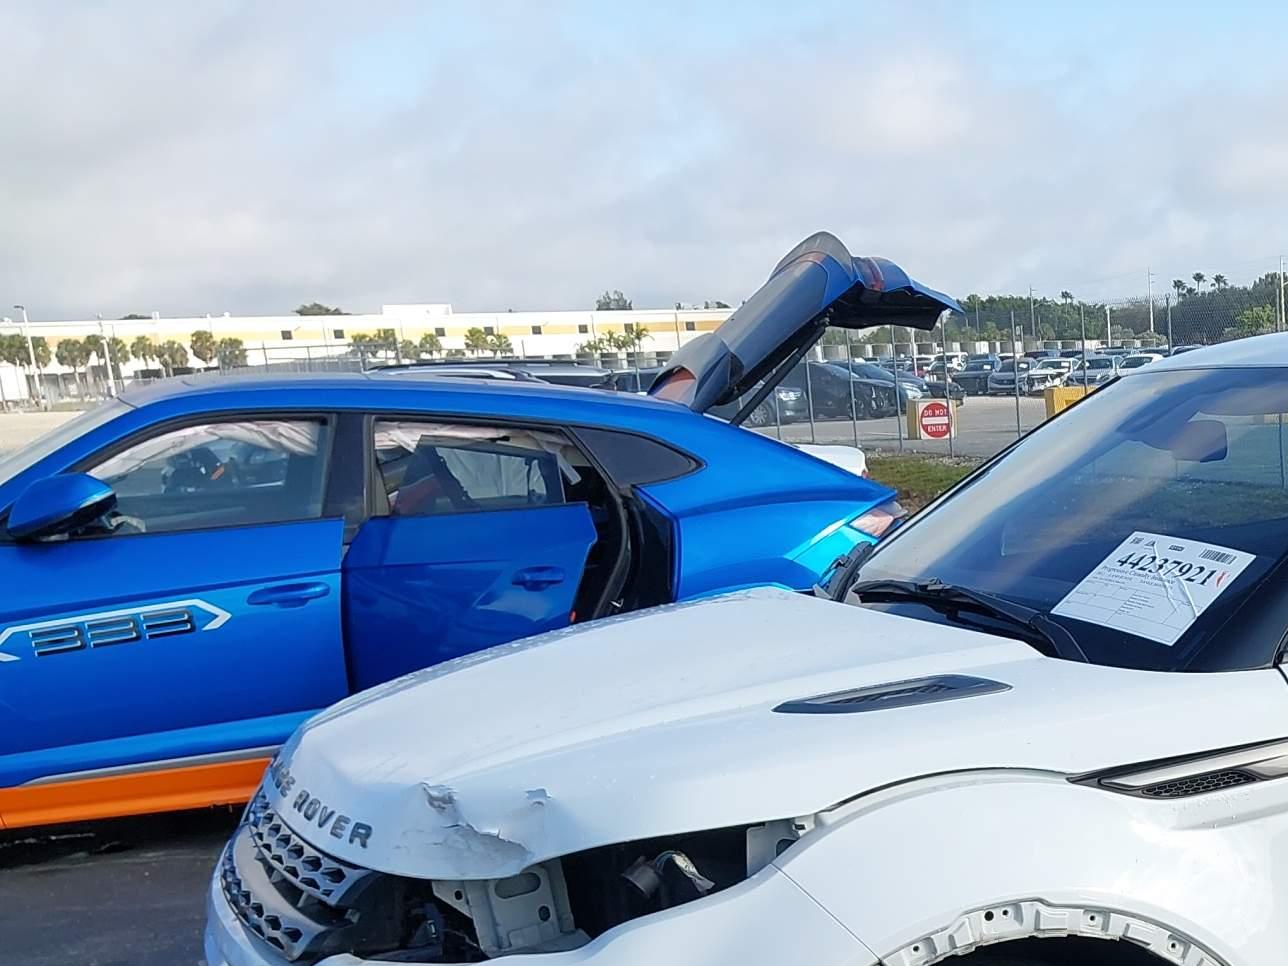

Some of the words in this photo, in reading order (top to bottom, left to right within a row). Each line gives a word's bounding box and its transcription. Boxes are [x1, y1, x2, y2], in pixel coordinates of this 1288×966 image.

[923, 409, 933, 417] DO
[934, 408, 948, 416] NOT
[1116, 552, 1217, 586] 44237921
[293, 789, 373, 849] ROVER
